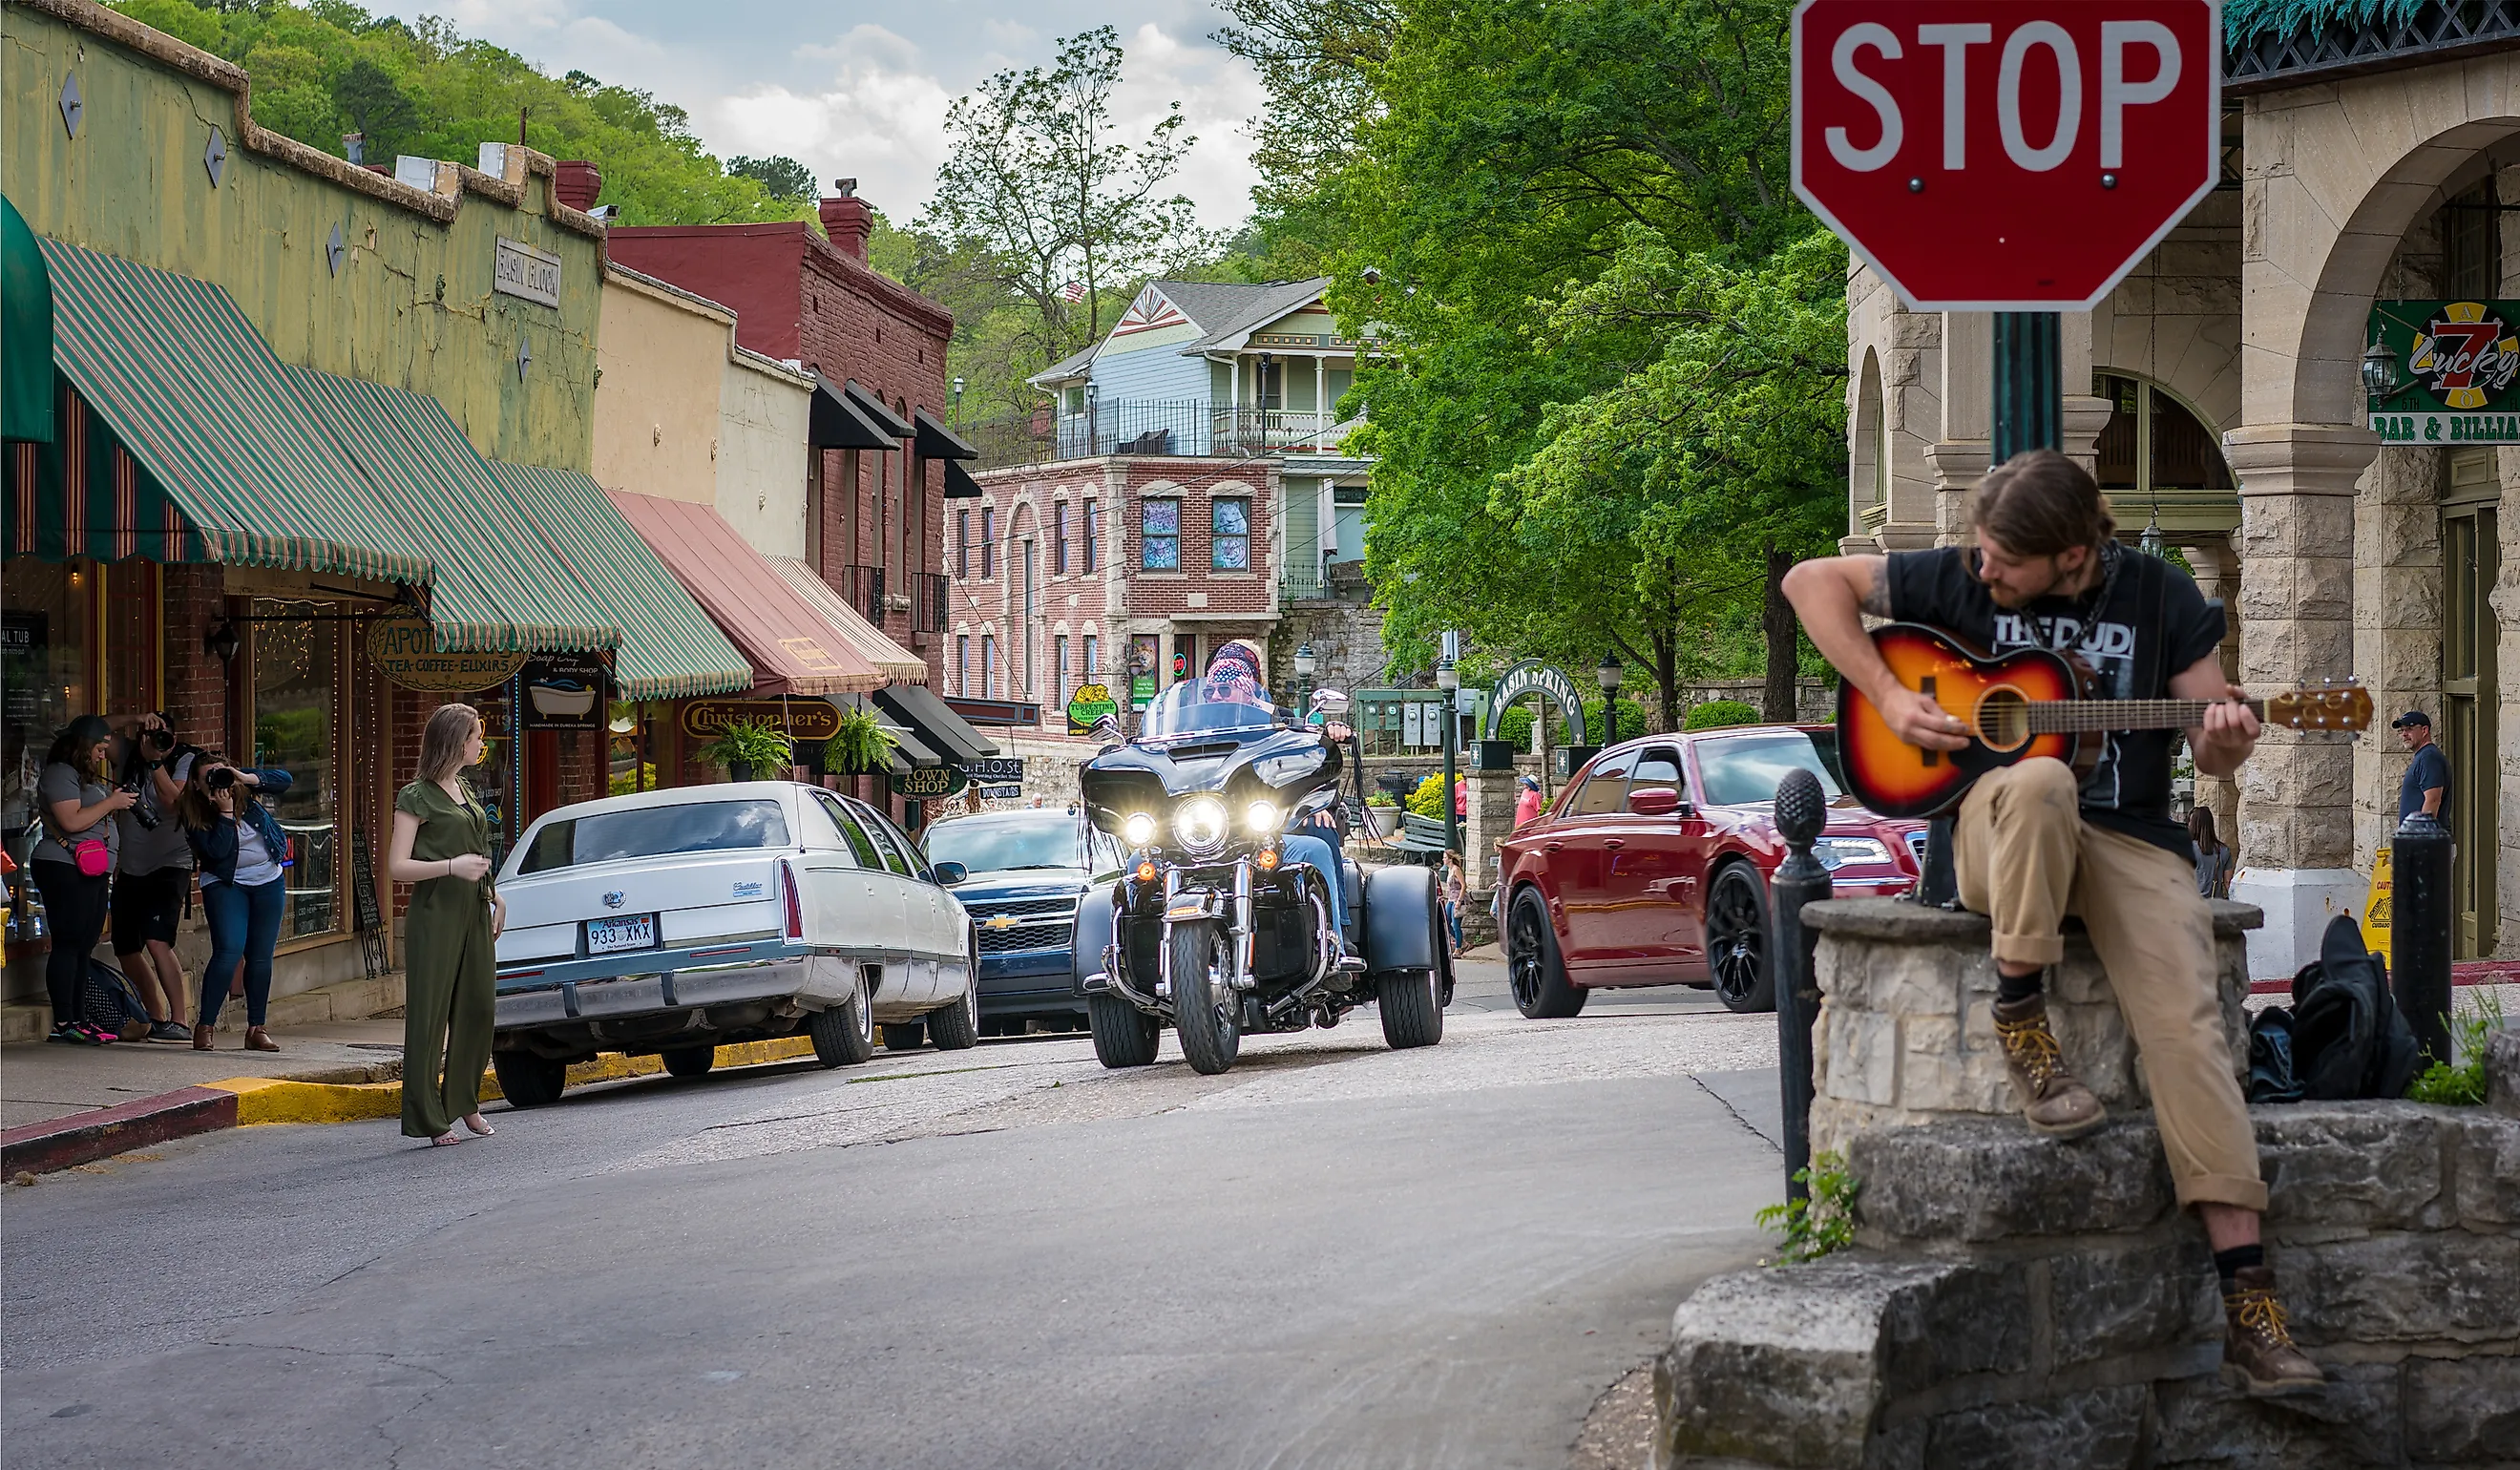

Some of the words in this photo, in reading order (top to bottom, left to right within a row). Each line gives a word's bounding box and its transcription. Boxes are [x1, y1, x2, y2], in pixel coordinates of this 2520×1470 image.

[1824, 19, 2183, 173] STOP
[497, 250, 525, 285] BASIN
[527, 261, 558, 300] BLOCK
[2408, 335, 2520, 390] Lucky
[2433, 322, 2500, 389] 7
[2374, 416, 2416, 441] BAR
[2424, 416, 2443, 441] &
[2449, 416, 2520, 441] BILLIA
[13, 630, 30, 643] TUB
[1494, 666, 1528, 717] BASIN
[1531, 667, 1577, 717] SPRING
[690, 703, 831, 731] Christopher's
[1070, 703, 1115, 711] TURPENTINE
[904, 768, 952, 782] TOWN
[904, 780, 949, 793] SHOP
[982, 787, 1019, 798] DOWNSTAIRS
[2377, 881, 2390, 890] CAUT
[601, 916, 639, 928] Arkansas
[591, 928, 617, 945] 933
[625, 923, 651, 942] XKX
